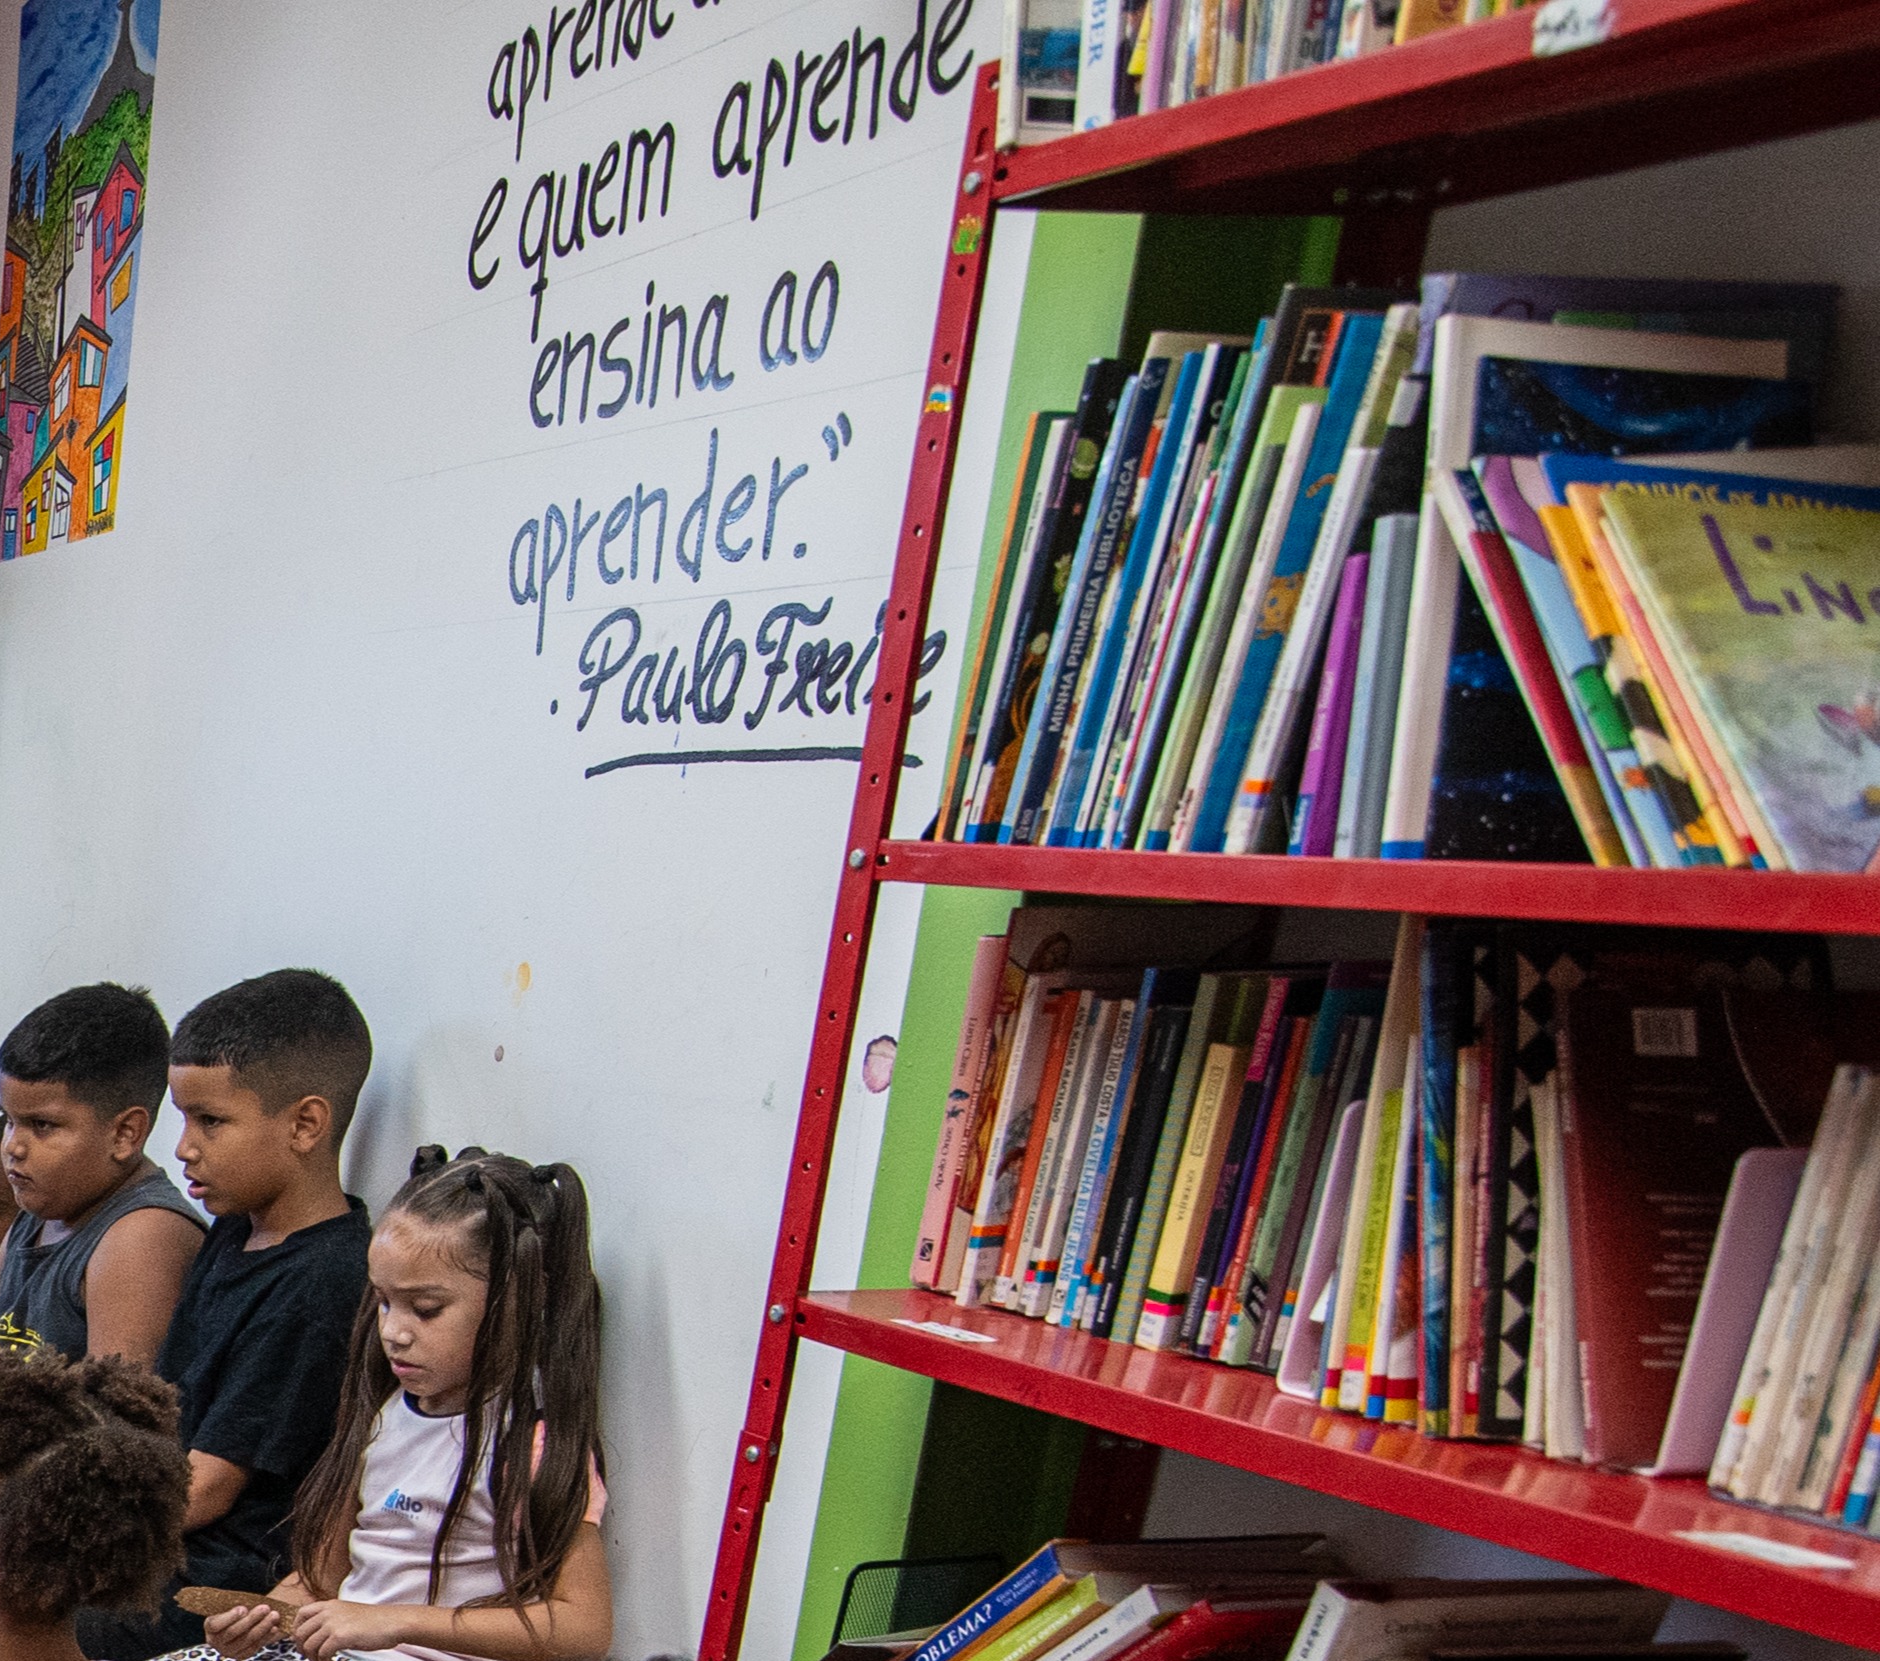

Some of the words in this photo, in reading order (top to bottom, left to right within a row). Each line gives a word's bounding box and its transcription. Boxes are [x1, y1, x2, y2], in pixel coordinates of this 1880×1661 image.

[468, 177, 509, 291] e
[517, 122, 676, 344] quem
[711, 0, 975, 221] aprende
[528, 280, 735, 428] ensina
[759, 260, 840, 372] ao
[1046, 669, 1076, 734] MINHA
[1065, 573, 1104, 668] PRIMEIRA
[1092, 454, 1139, 573] BIBLIOTECA
[743, 596, 947, 731] Freie
[1073, 1005, 1087, 1030] ANA
[1112, 1009, 1134, 1052] MARCO
[1062, 1029, 1082, 1068] MARIA
[1048, 1068, 1072, 1124] MACHADO
[1092, 1122, 1106, 1136] A
[1077, 1138, 1103, 1196] OVELHA
[1068, 1196, 1088, 1233] BLUE
[1057, 1234, 1080, 1282] JEANS
